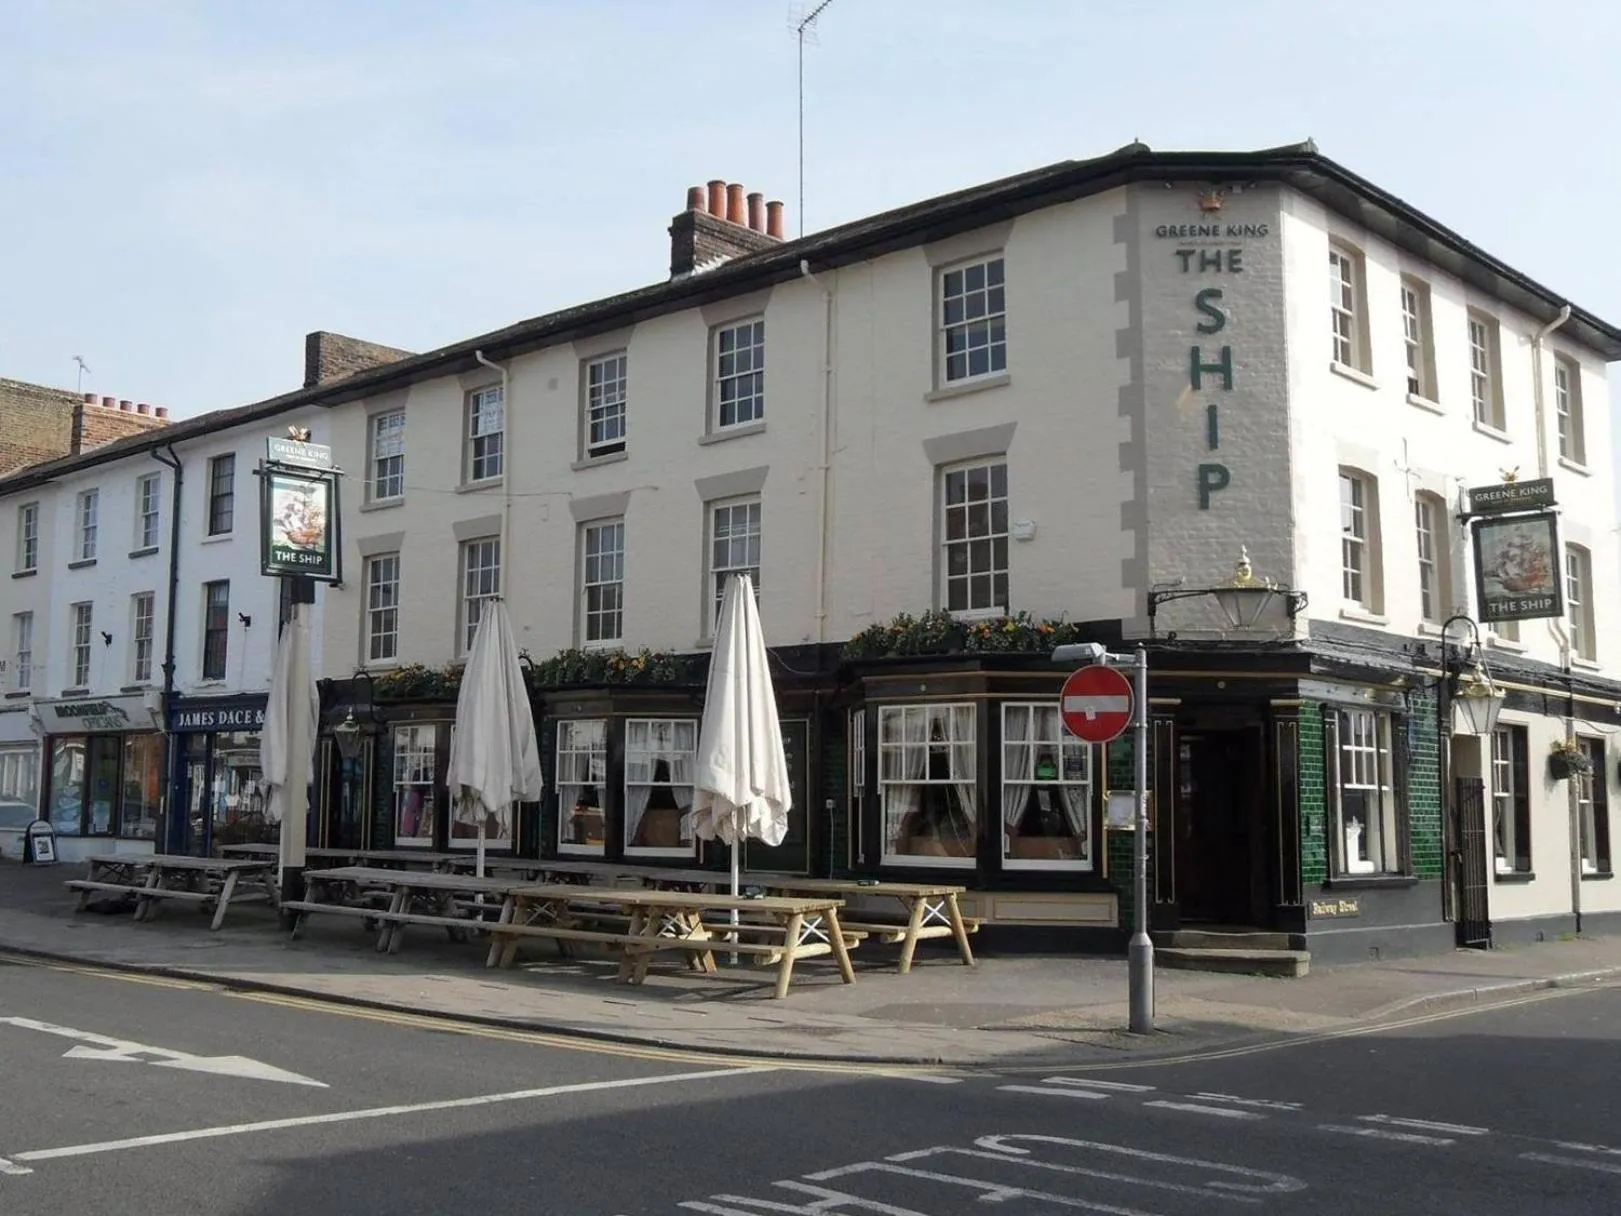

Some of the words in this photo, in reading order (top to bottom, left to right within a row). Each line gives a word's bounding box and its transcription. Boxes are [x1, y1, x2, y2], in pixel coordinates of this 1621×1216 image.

[1155, 224, 1220, 238] GREENE
[1226, 223, 1269, 238] KING
[1174, 248, 1244, 273] THE
[1190, 288, 1233, 510] SHIP
[1475, 488, 1517, 502] GREENE
[1519, 485, 1548, 496] KING
[275, 550, 297, 563] THE
[299, 552, 323, 565] SHIP
[1489, 601, 1517, 613] THE
[1520, 599, 1552, 611] SHIP
[179, 711, 215, 727] JAMES
[218, 710, 252, 724] DACE
